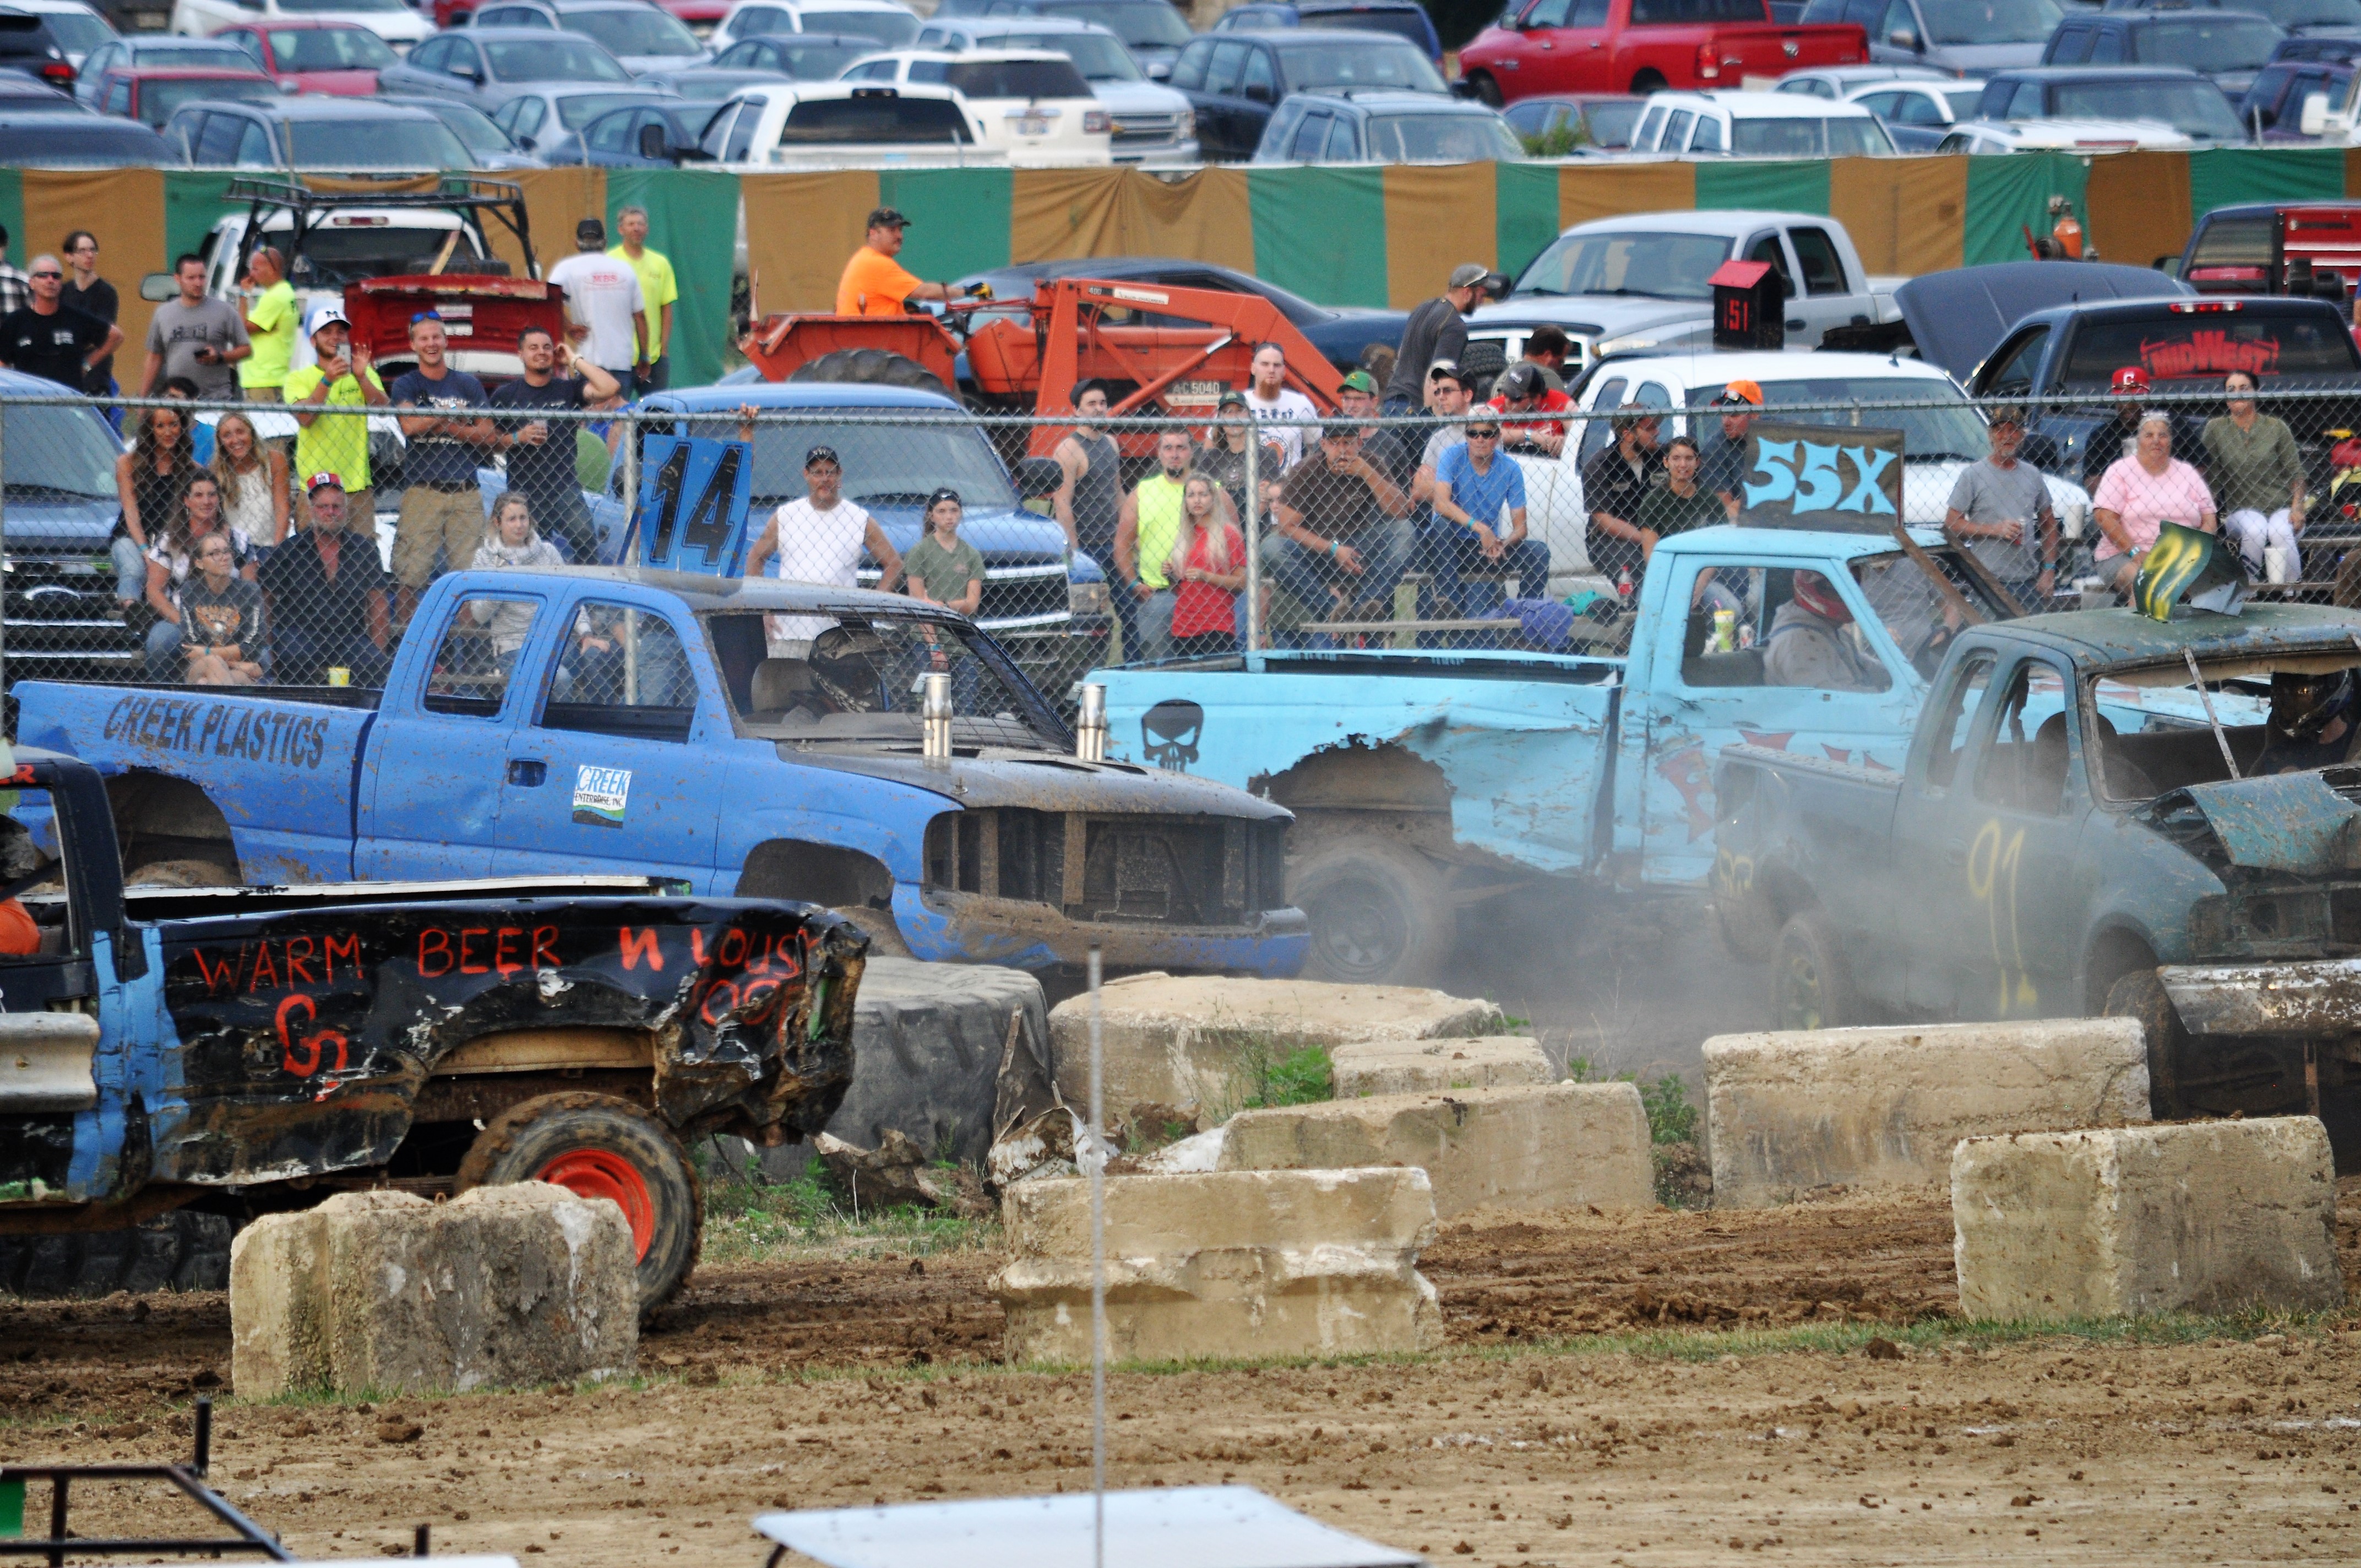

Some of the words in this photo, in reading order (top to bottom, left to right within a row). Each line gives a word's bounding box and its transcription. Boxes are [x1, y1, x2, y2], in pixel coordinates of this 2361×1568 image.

[1192, 380, 1220, 394] 5040
[650, 442, 743, 567] 14
[1743, 435, 1898, 515] 55X
[104, 695, 204, 751] CREEK
[199, 704, 329, 770] PLASTICS
[576, 766, 632, 797] CREEK
[193, 932, 364, 995] WARM
[418, 925, 562, 980] BEER
